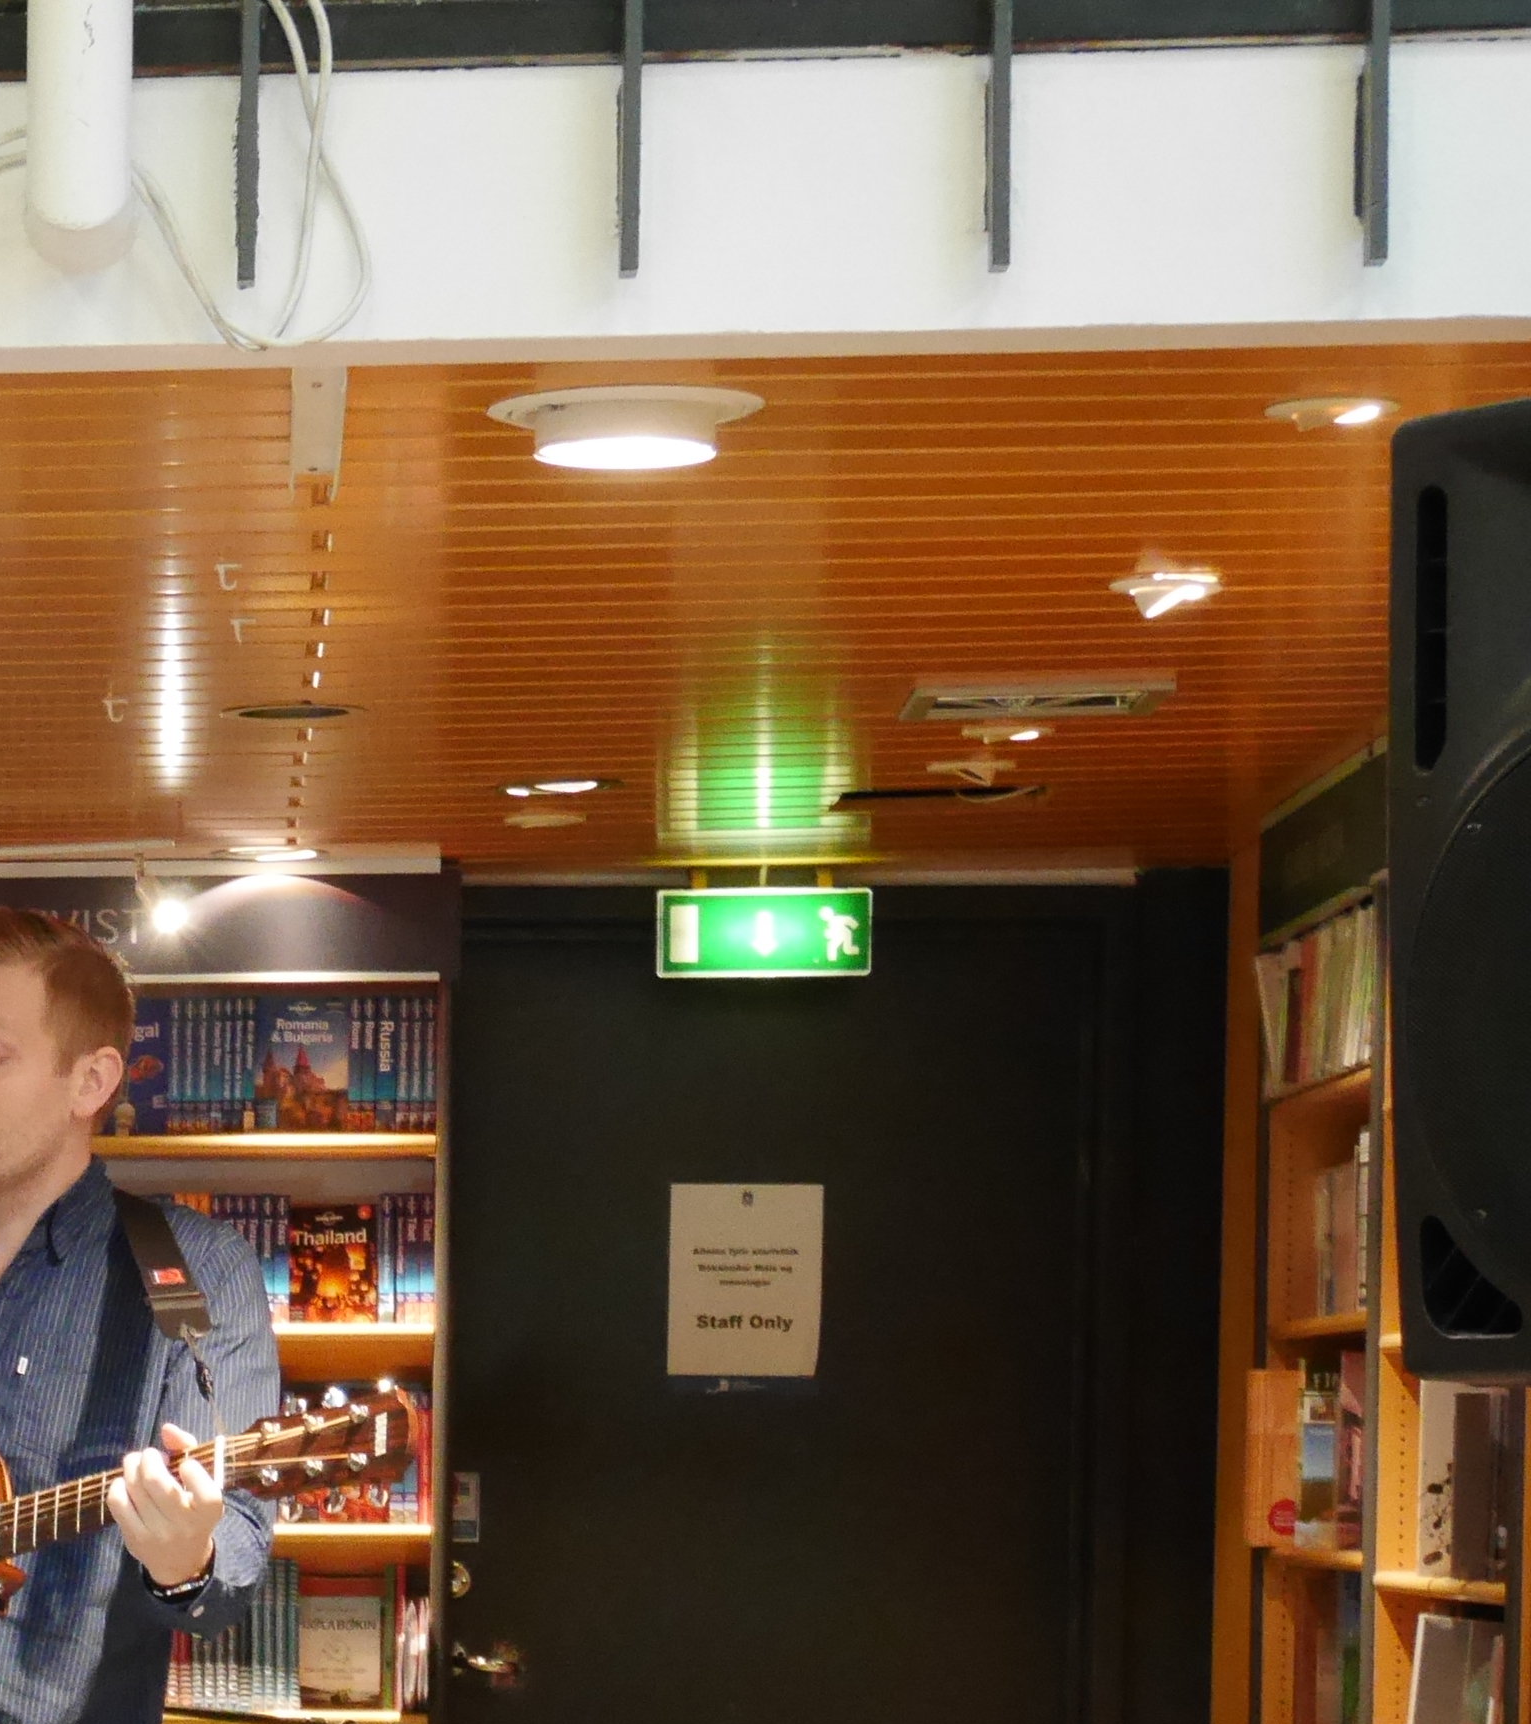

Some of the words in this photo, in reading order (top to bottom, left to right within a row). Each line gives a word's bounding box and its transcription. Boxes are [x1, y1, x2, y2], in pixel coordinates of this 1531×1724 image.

[276, 1018, 329, 1031] Romania
[270, 1031, 281, 1043] &
[283, 1030, 334, 1046] Bulgaria
[379, 1020, 395, 1072] Russia
[277, 1218, 288, 1246] Texas
[296, 1227, 367, 1246] Thailand
[696, 1313, 743, 1329] Staff
[749, 1313, 793, 1332] Only
